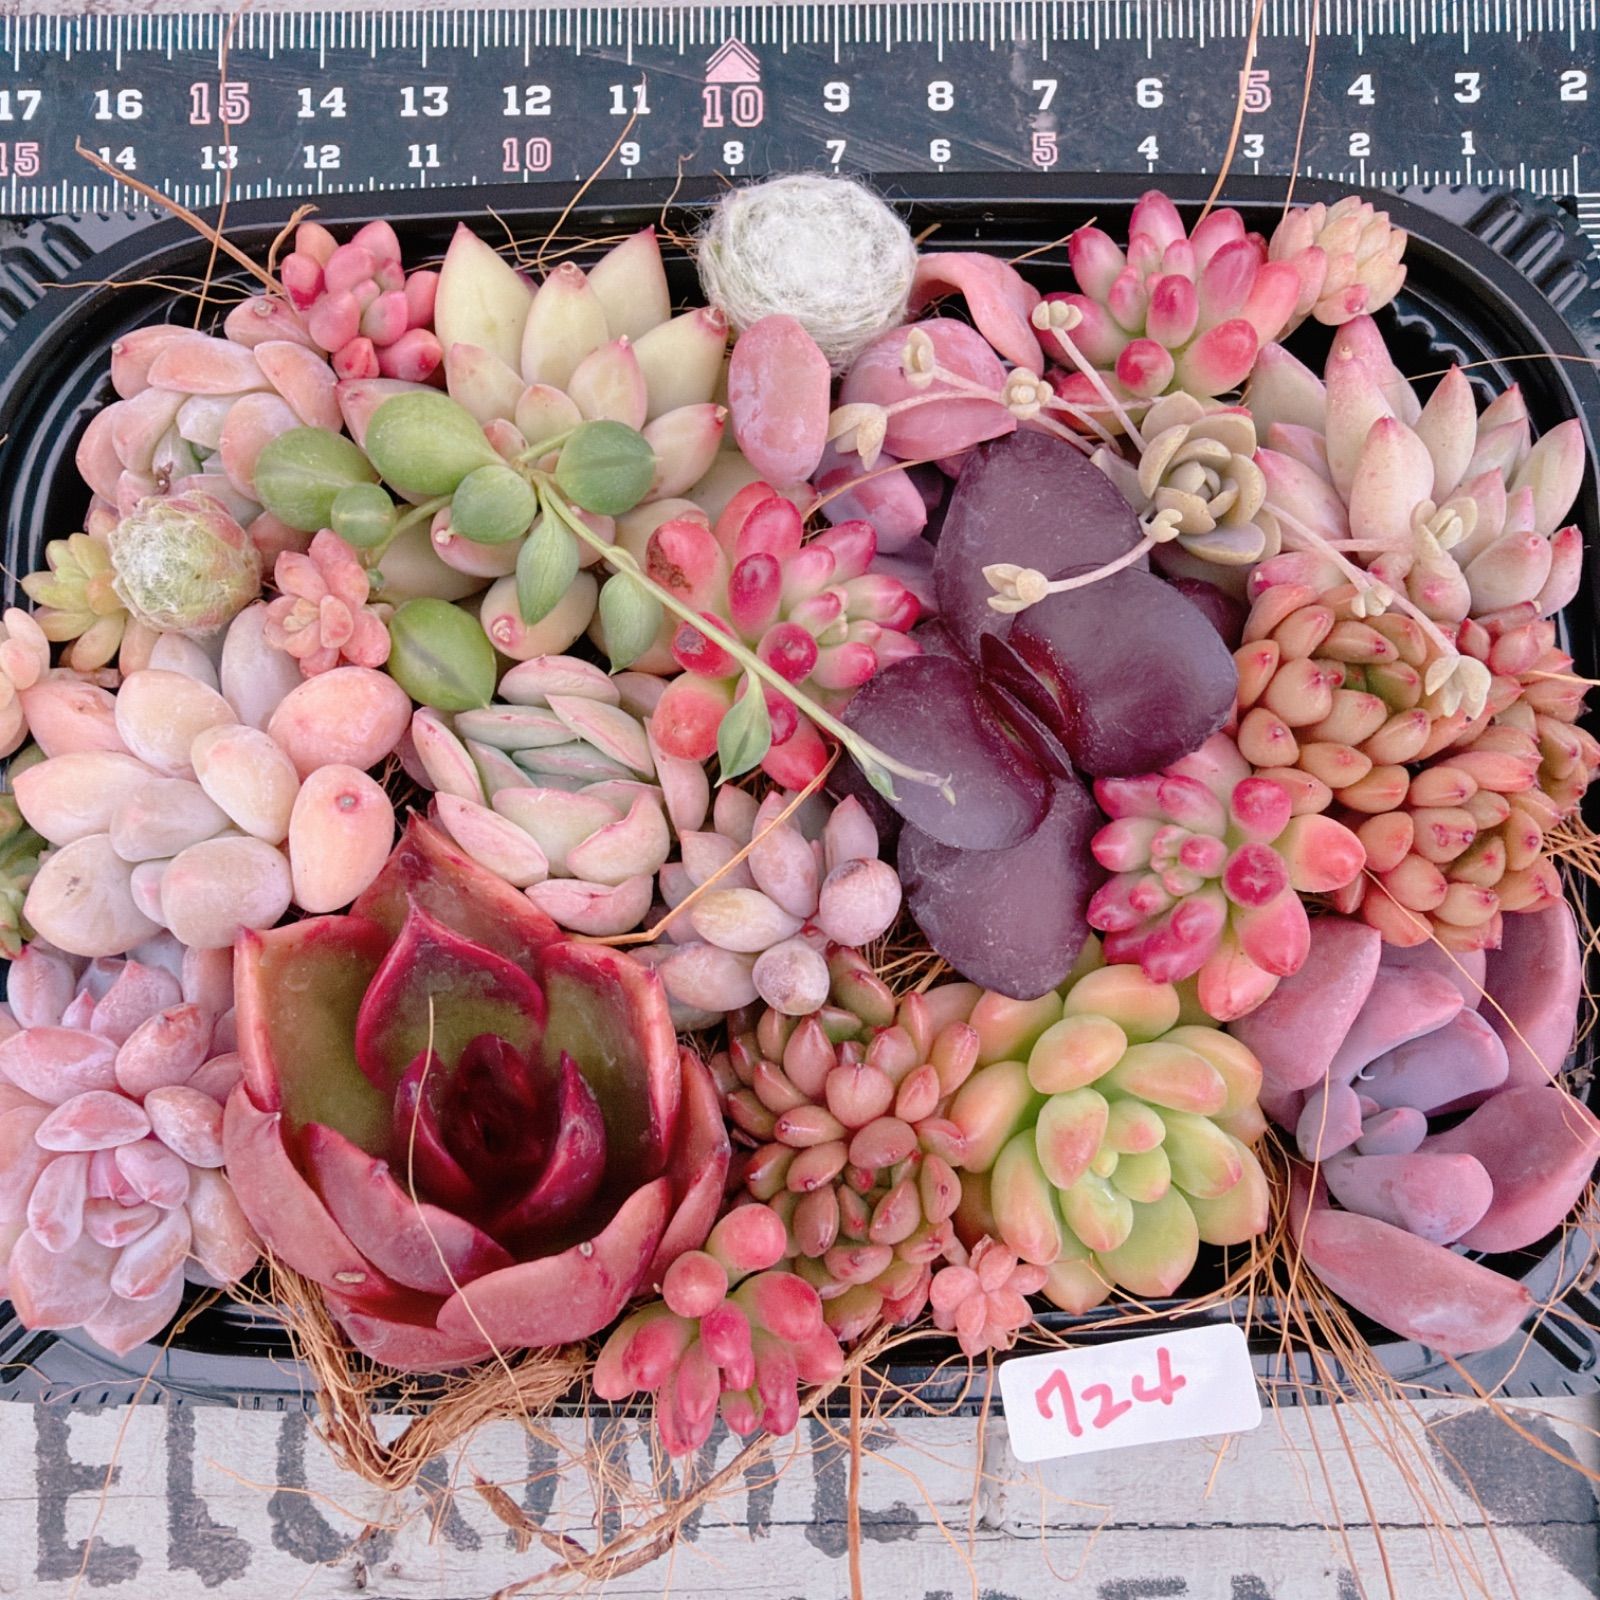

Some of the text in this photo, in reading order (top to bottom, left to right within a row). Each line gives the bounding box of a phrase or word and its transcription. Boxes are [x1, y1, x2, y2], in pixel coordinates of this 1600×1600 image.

[0, 70, 1587, 128] 17 16 15 14 13 12 11 10 9 8 7 6 5 4 3 2
[99, 146, 136, 170] 14
[200, 145, 238, 170] 13
[304, 145, 340, 168] 12
[409, 144, 440, 167] 11
[502, 137, 551, 171] 10
[619, 142, 640, 166] 9
[724, 141, 744, 164] 8
[827, 140, 846, 163] 7
[930, 139, 950, 162] 6
[1032, 132, 1057, 166] 5
[1138, 136, 1158, 160] 4
[1244, 134, 1264, 158] 3
[1349, 133, 1370, 156] 2
[1462, 131, 1475, 154] 1
[1035, 1347, 1187, 1437] 724
